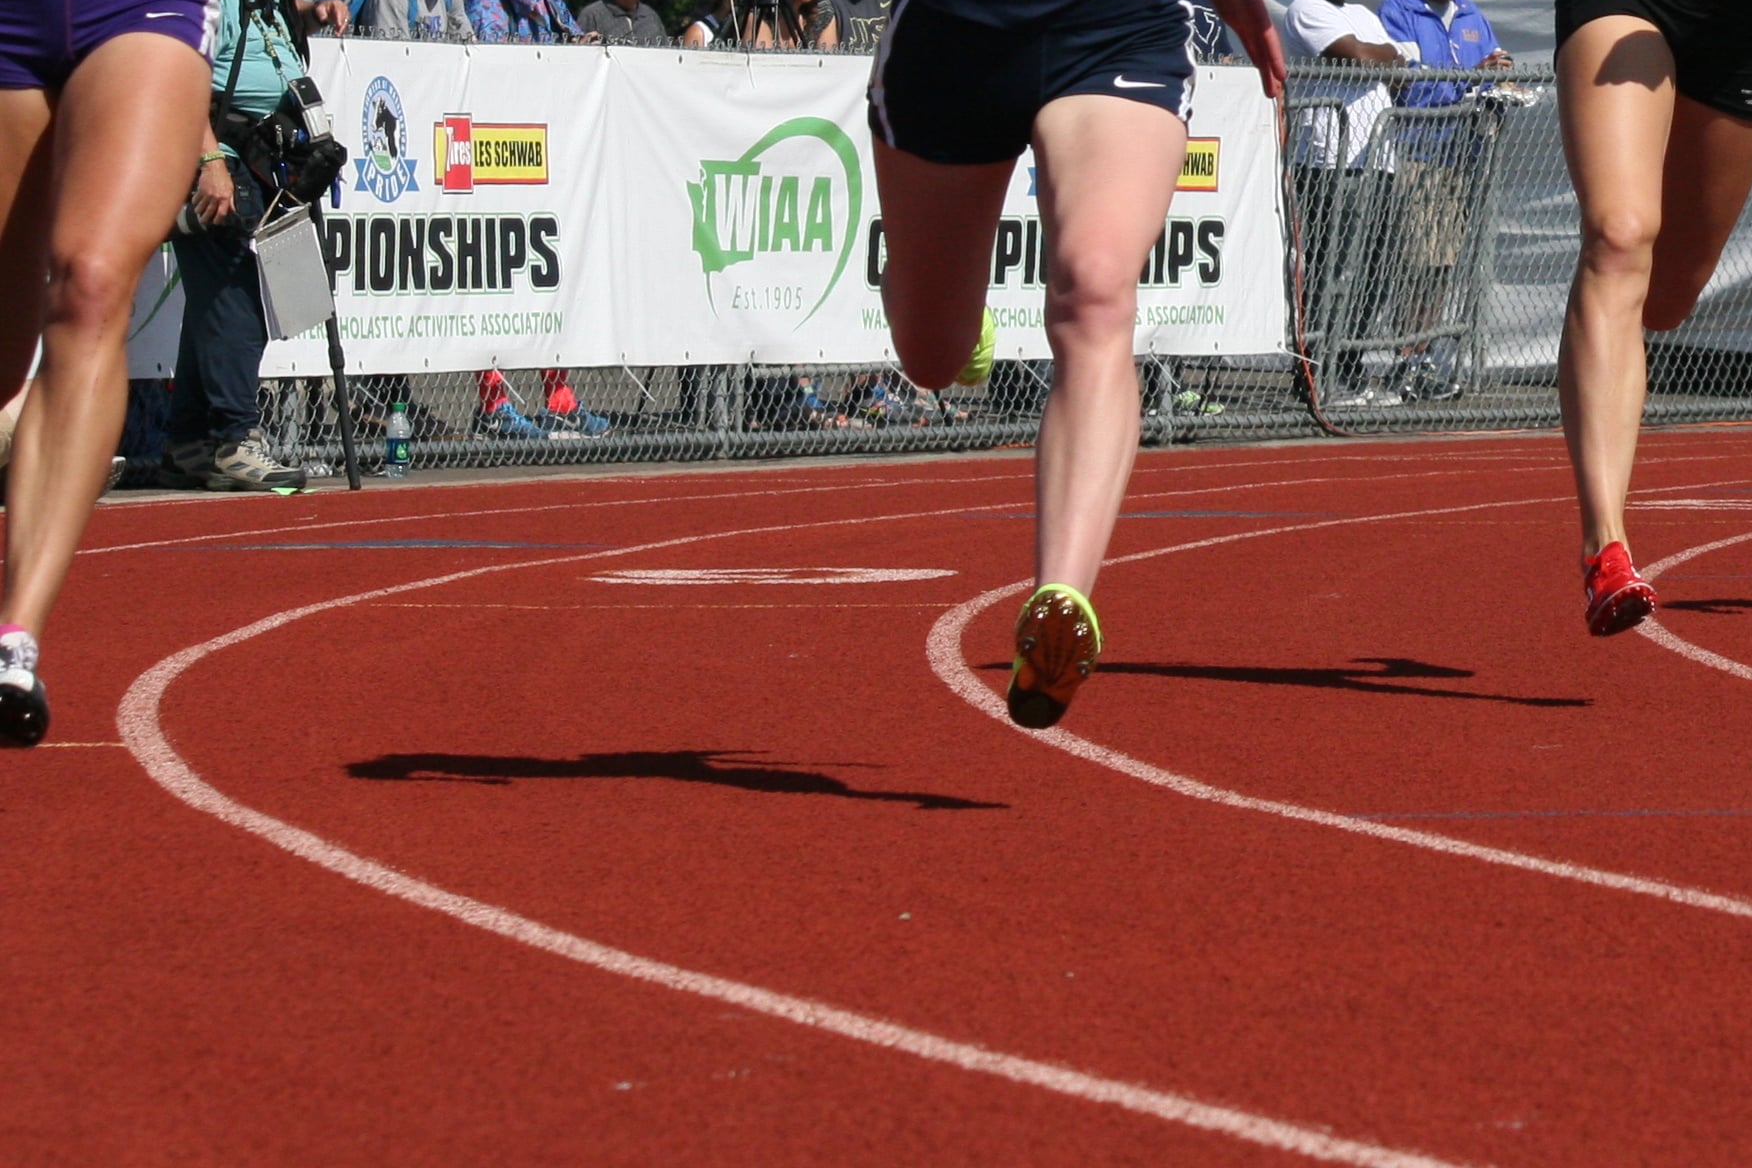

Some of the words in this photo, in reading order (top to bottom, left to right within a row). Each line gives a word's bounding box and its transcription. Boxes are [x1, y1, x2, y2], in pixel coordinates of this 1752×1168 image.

[445, 126, 471, 172] Tires
[474, 141, 492, 168] LES
[494, 140, 543, 168] SCHWAB
[1183, 152, 1214, 176] HWAB
[366, 162, 407, 202] PRIDE
[715, 173, 834, 253] WIAA
[325, 217, 560, 292] PIONSHIPS
[408, 315, 476, 337] ACTIVITIES
[480, 312, 563, 335] ASSOCIATION
[1147, 305, 1225, 326] ASSOCIATION
